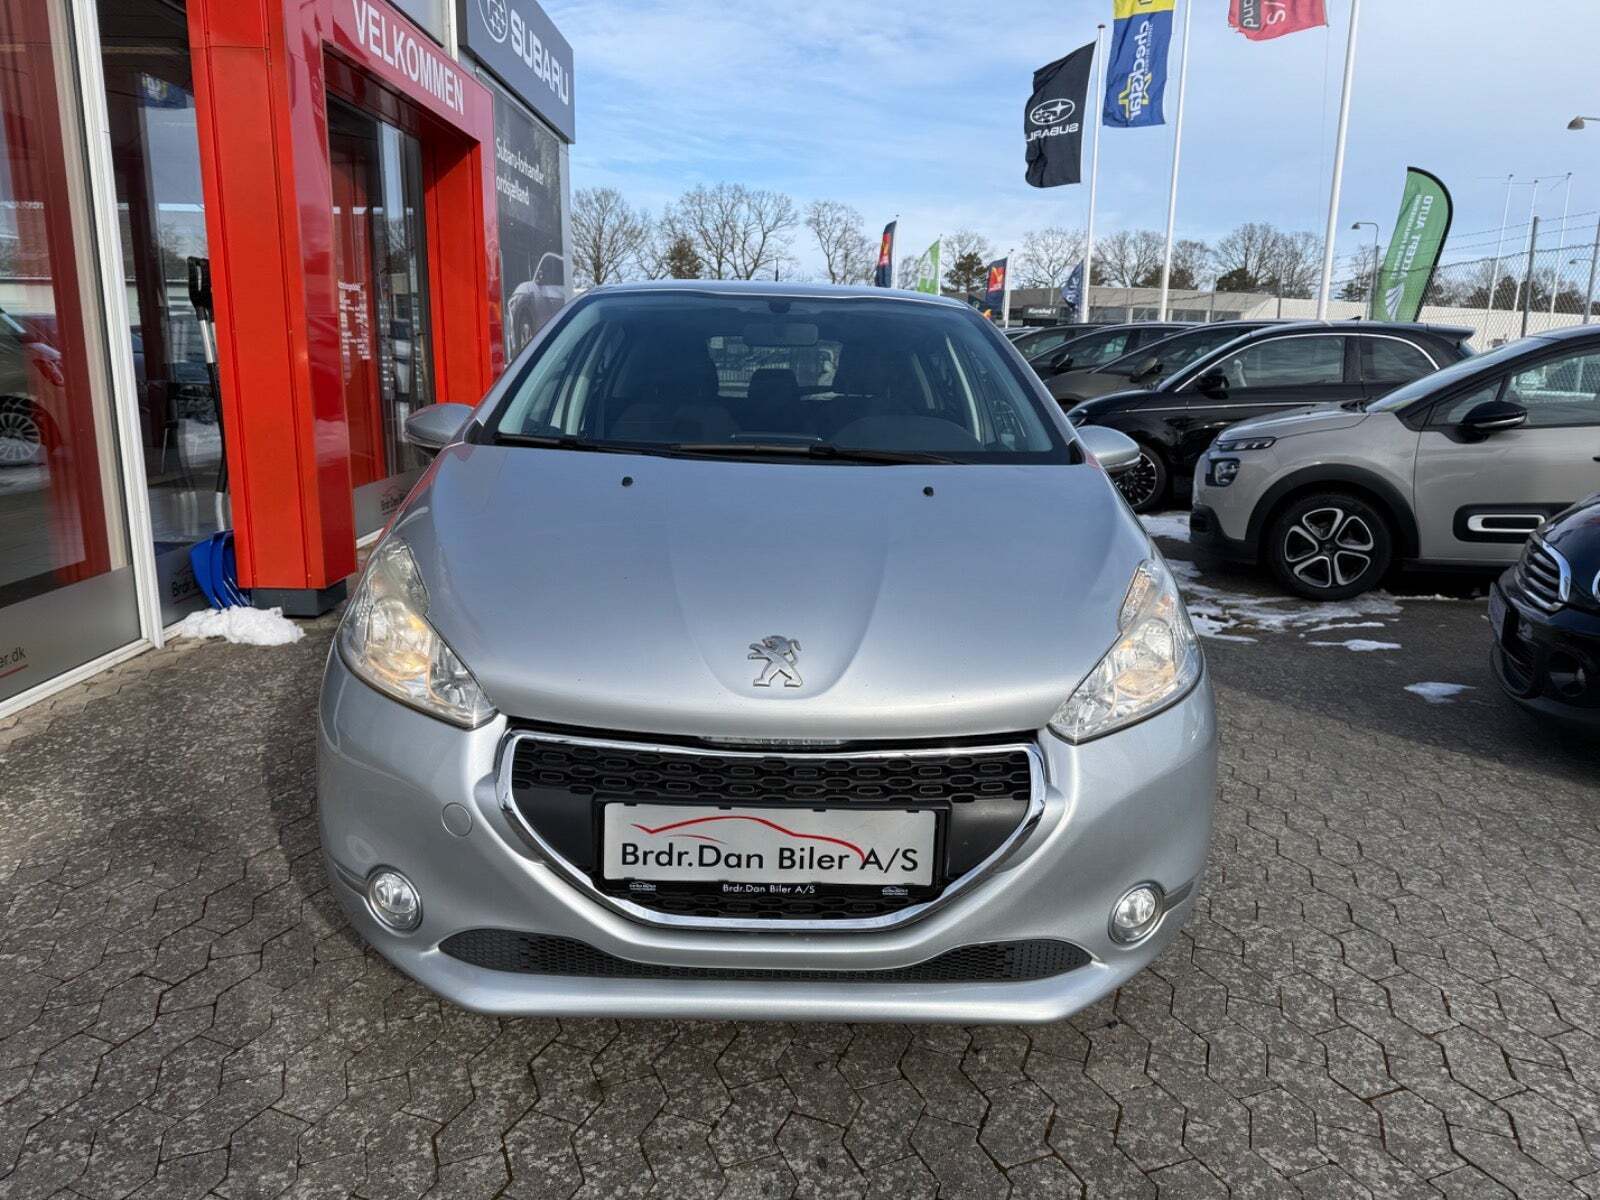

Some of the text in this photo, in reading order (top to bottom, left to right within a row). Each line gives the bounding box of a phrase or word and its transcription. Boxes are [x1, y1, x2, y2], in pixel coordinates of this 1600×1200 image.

[353, 0, 464, 116] VELKOMMEN
[510, 9, 569, 106] SUBARU
[495, 172, 530, 206] ordsjælland
[621, 842, 919, 873] Brdr.Dan Biler A/S
[722, 883, 816, 894] Brdr.Dan Biler A/S
